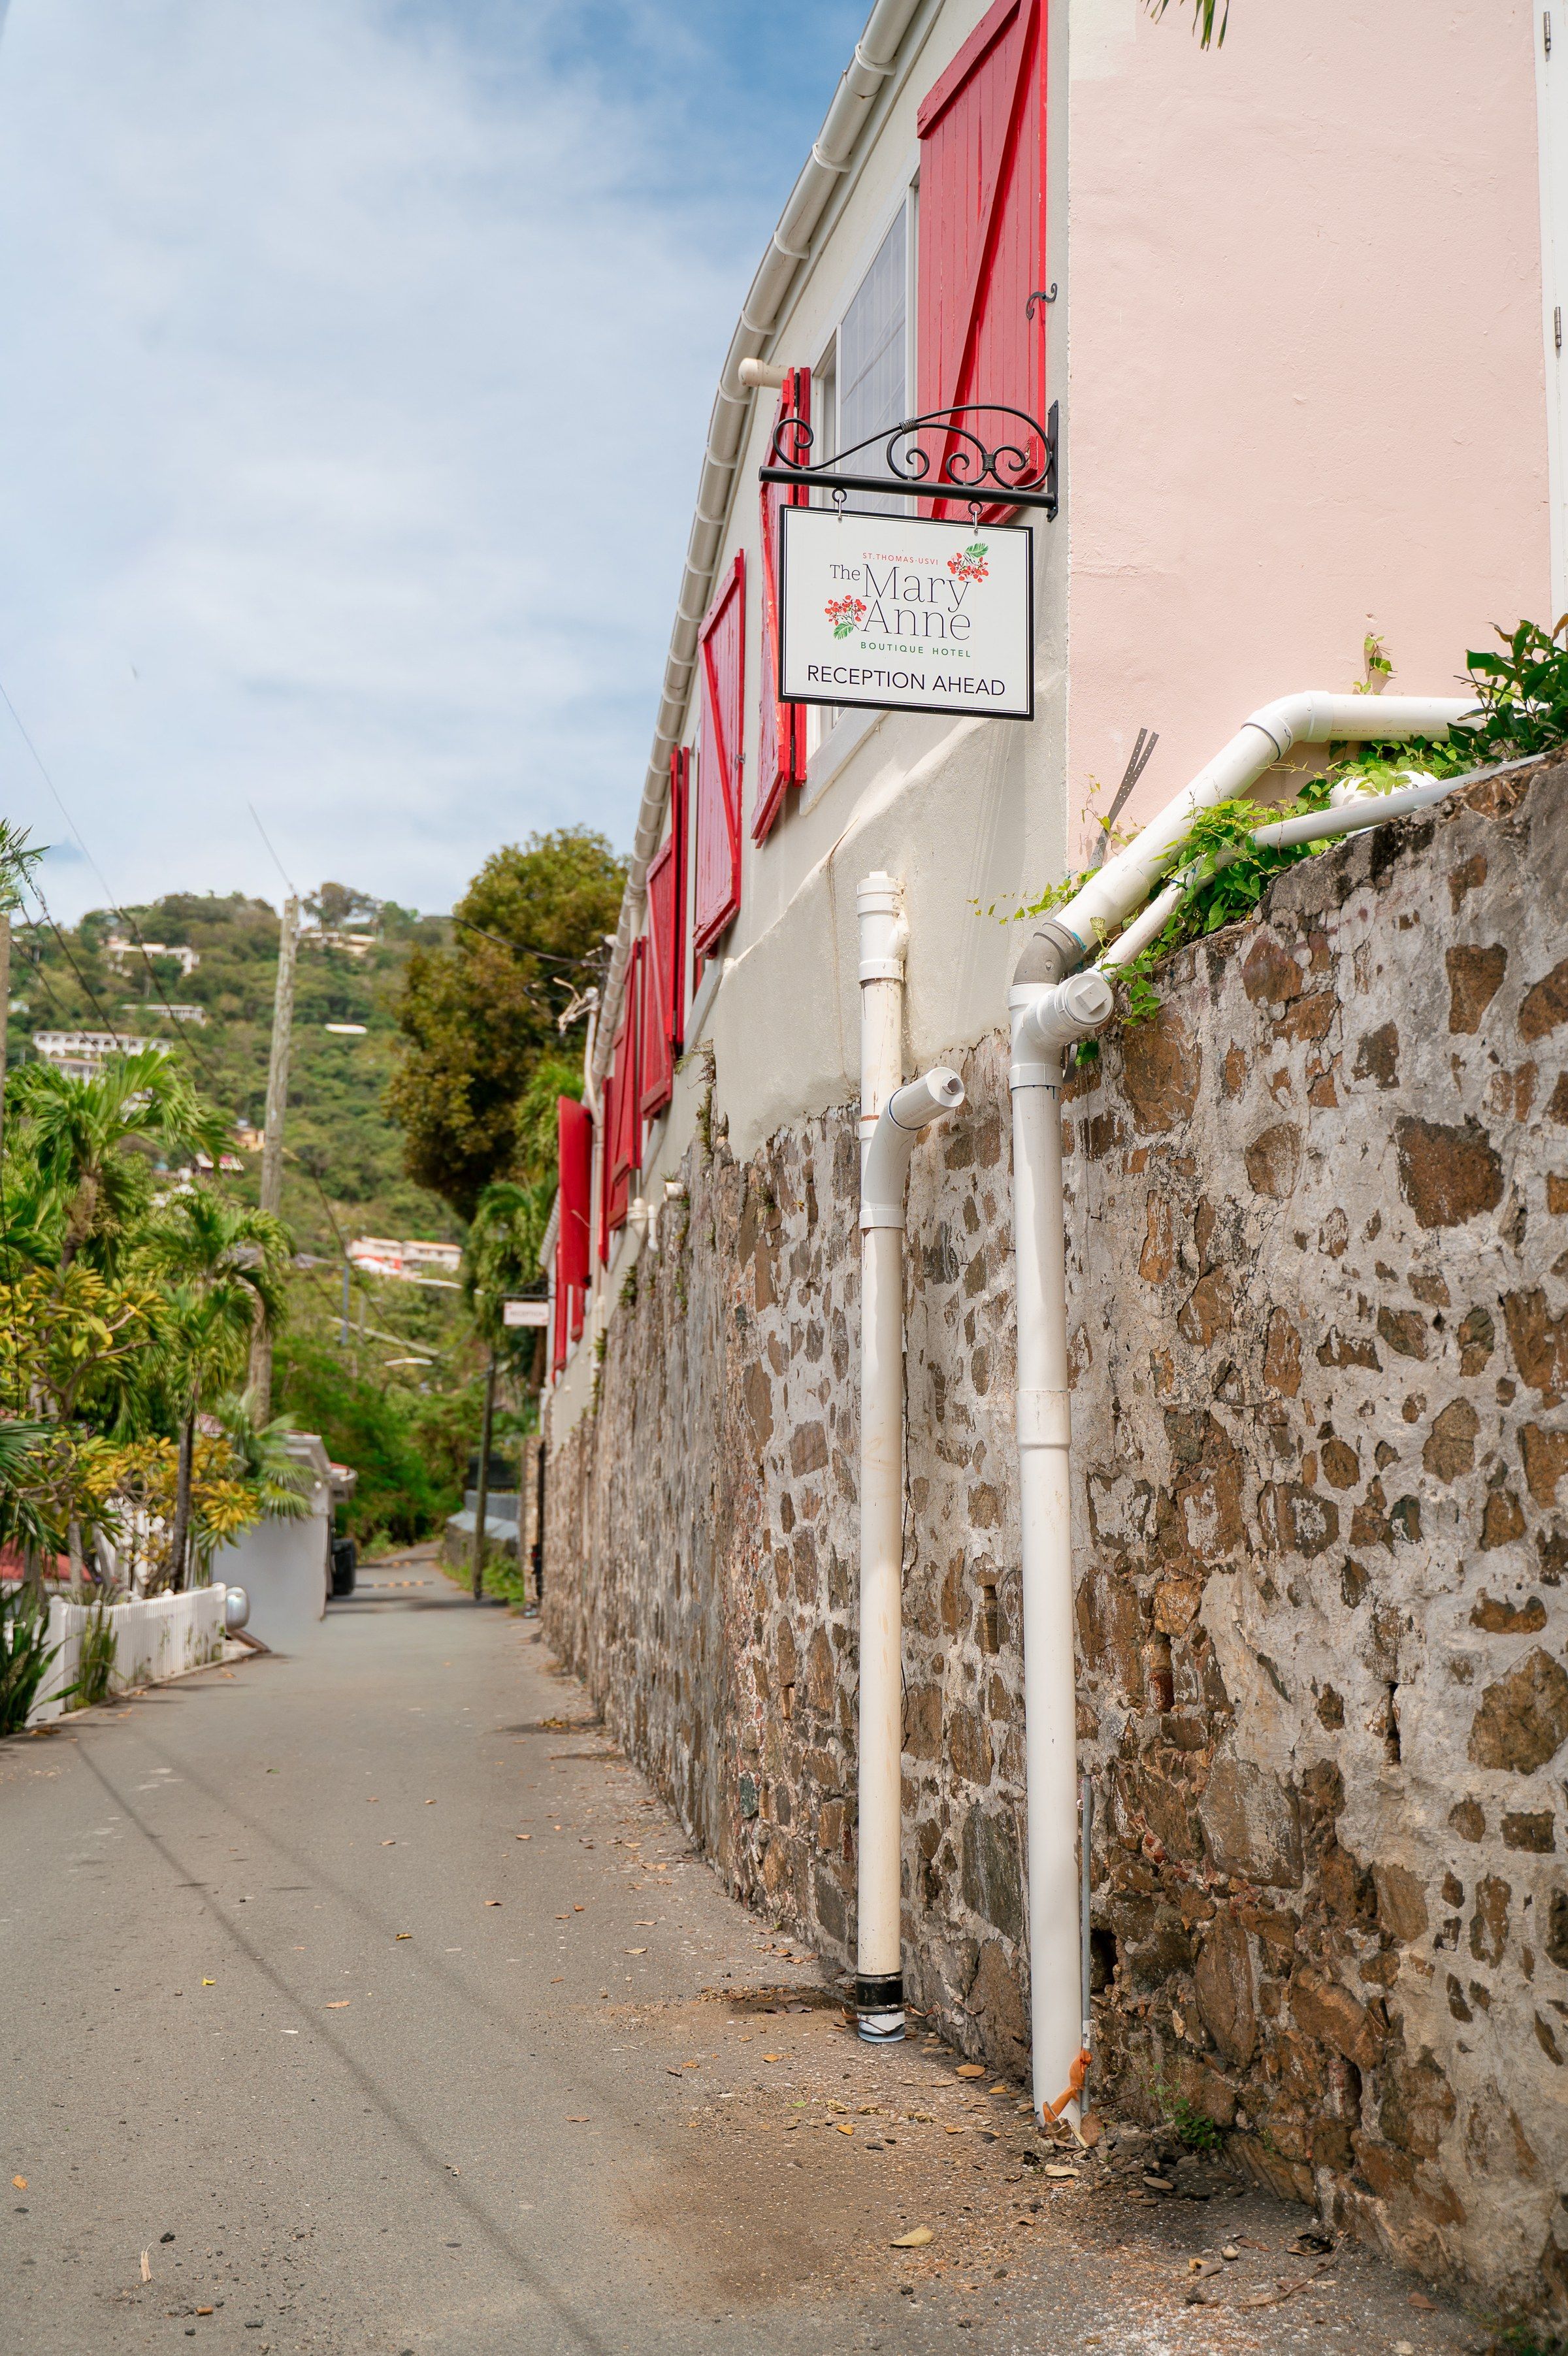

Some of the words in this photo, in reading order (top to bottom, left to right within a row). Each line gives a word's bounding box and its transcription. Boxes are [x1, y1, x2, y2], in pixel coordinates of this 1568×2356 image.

[829, 564, 861, 581] The
[862, 563, 972, 613] Mary
[860, 599, 971, 641] Anne
[860, 641, 924, 654] BOUTIQUE
[932, 647, 972, 658] HOTEL
[807, 664, 926, 691] RECEPTION
[932, 675, 1006, 696] AHEAD
